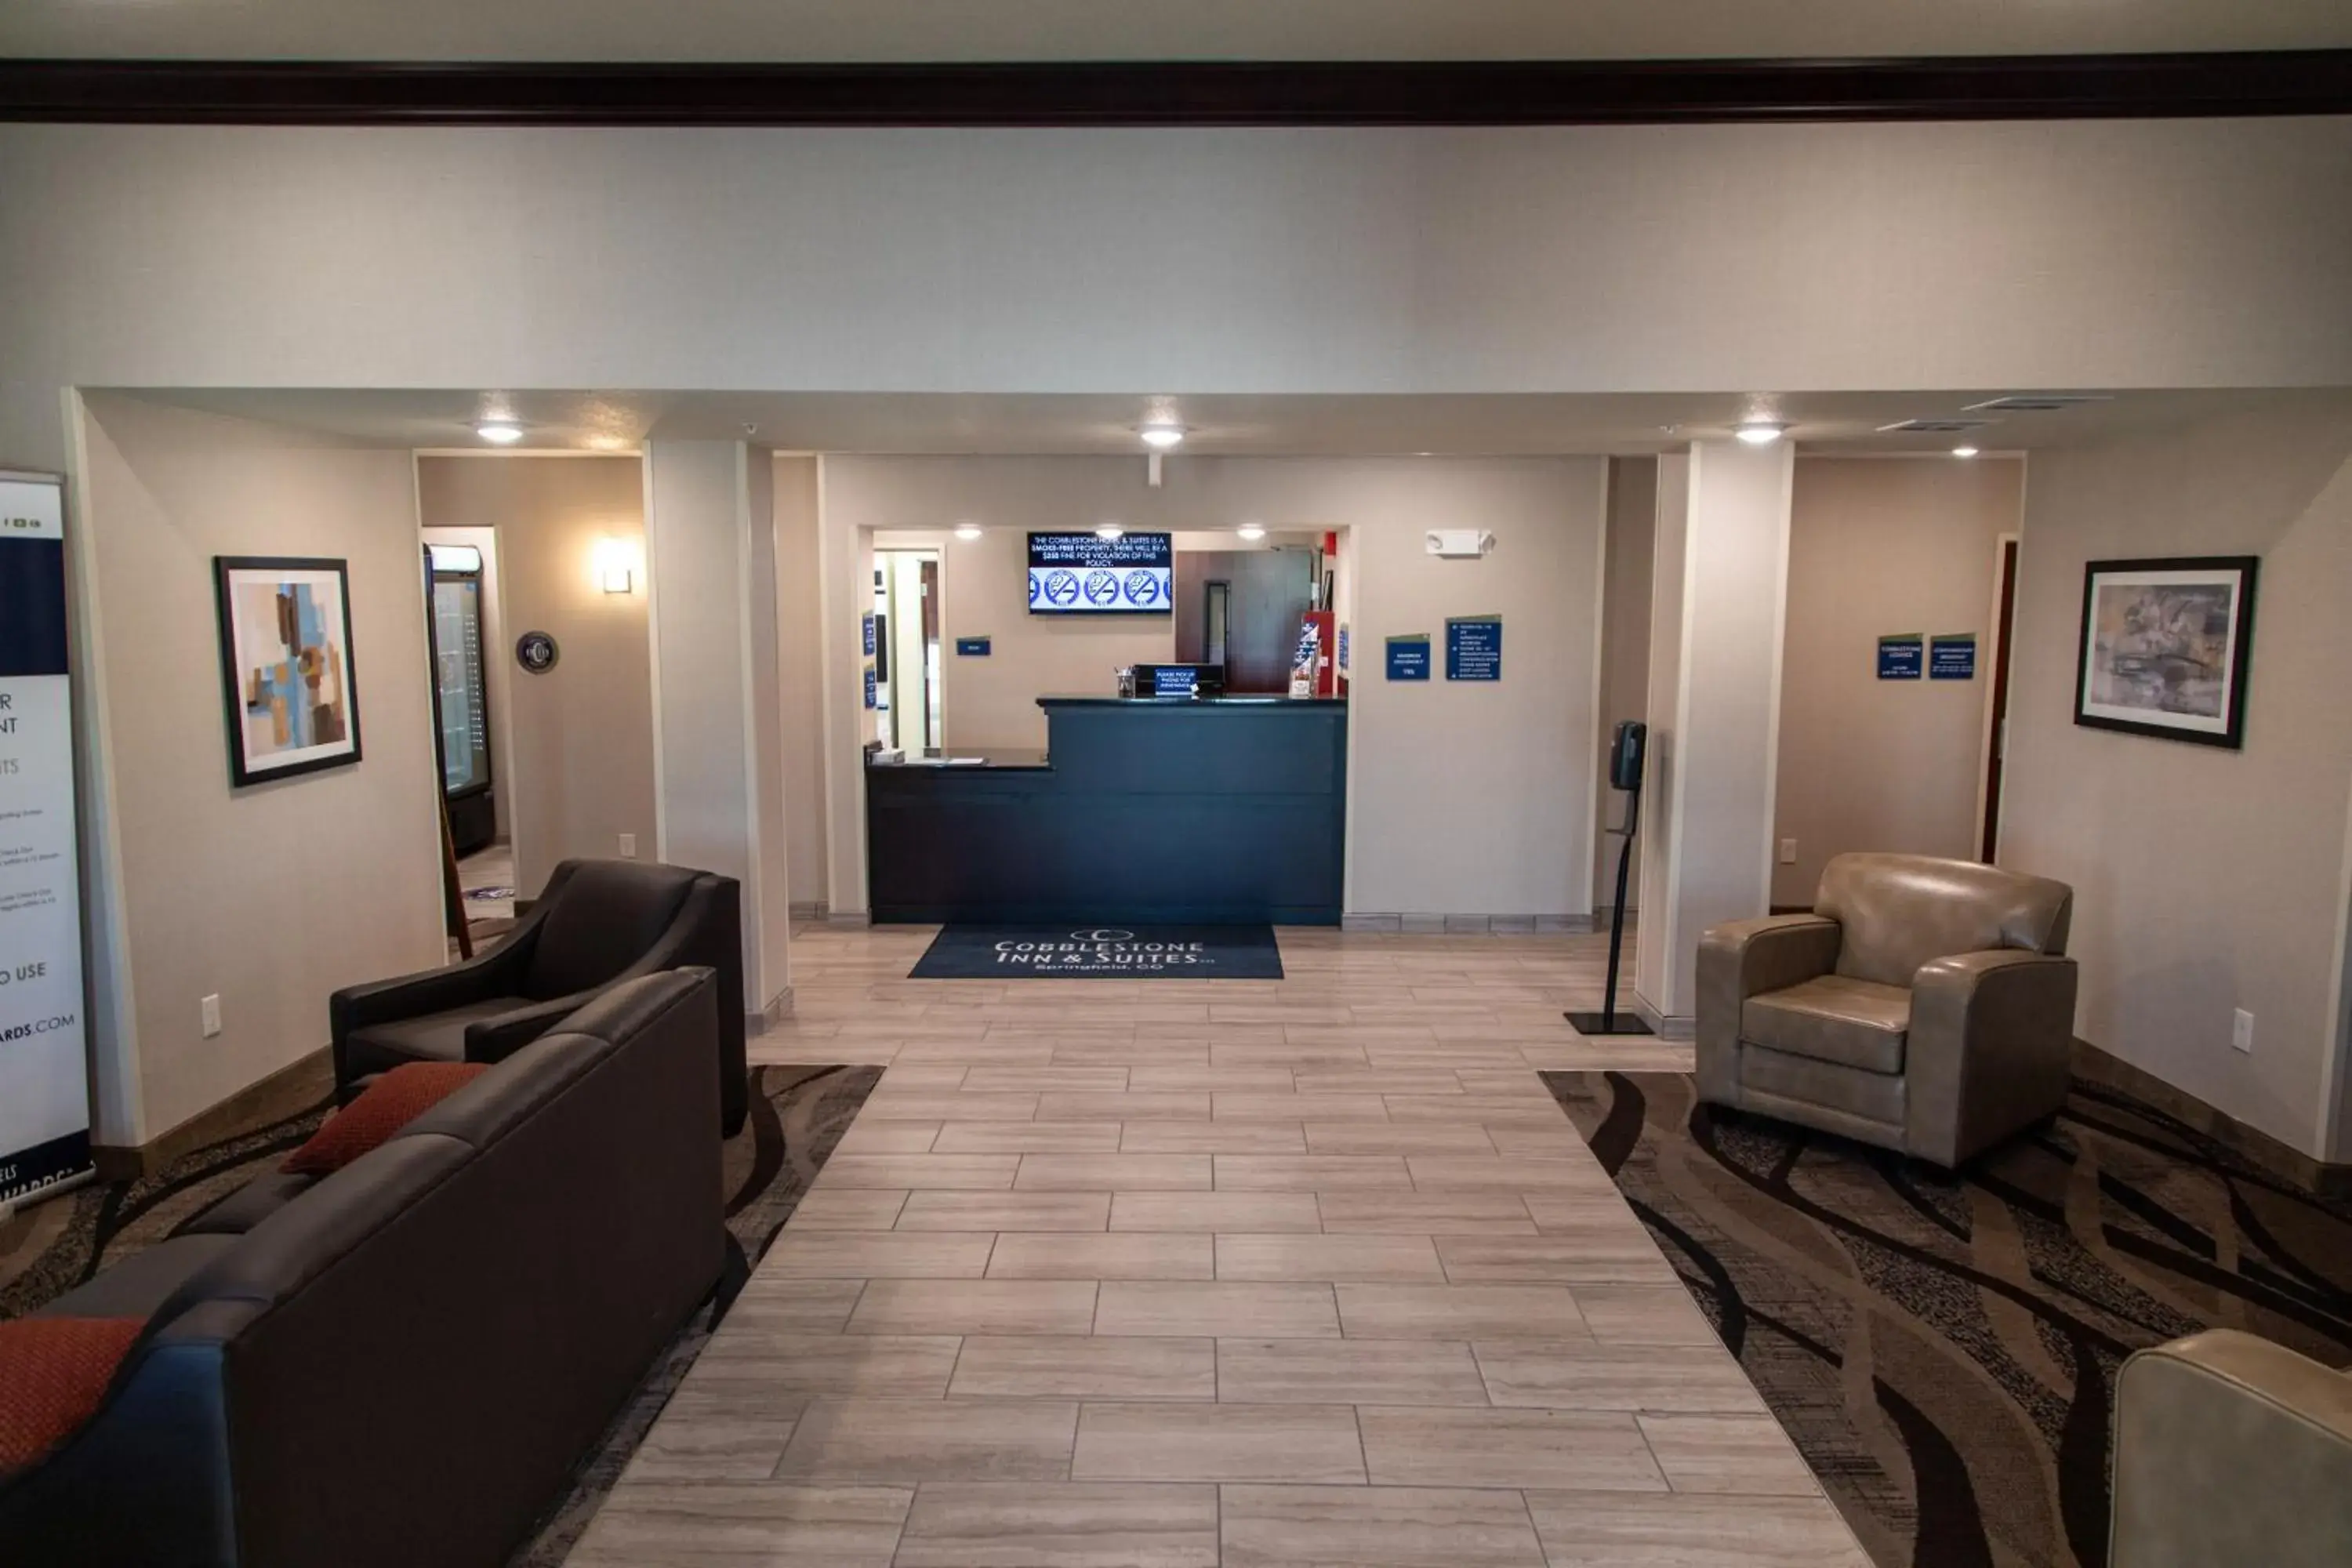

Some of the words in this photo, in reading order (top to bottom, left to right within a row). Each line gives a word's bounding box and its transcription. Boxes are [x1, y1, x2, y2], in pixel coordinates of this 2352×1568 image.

[995, 942, 1203, 952] COBBLESTONE
[997, 953, 1052, 964] INN
[1062, 954, 1082, 964] &
[16, 962, 47, 981] USE
